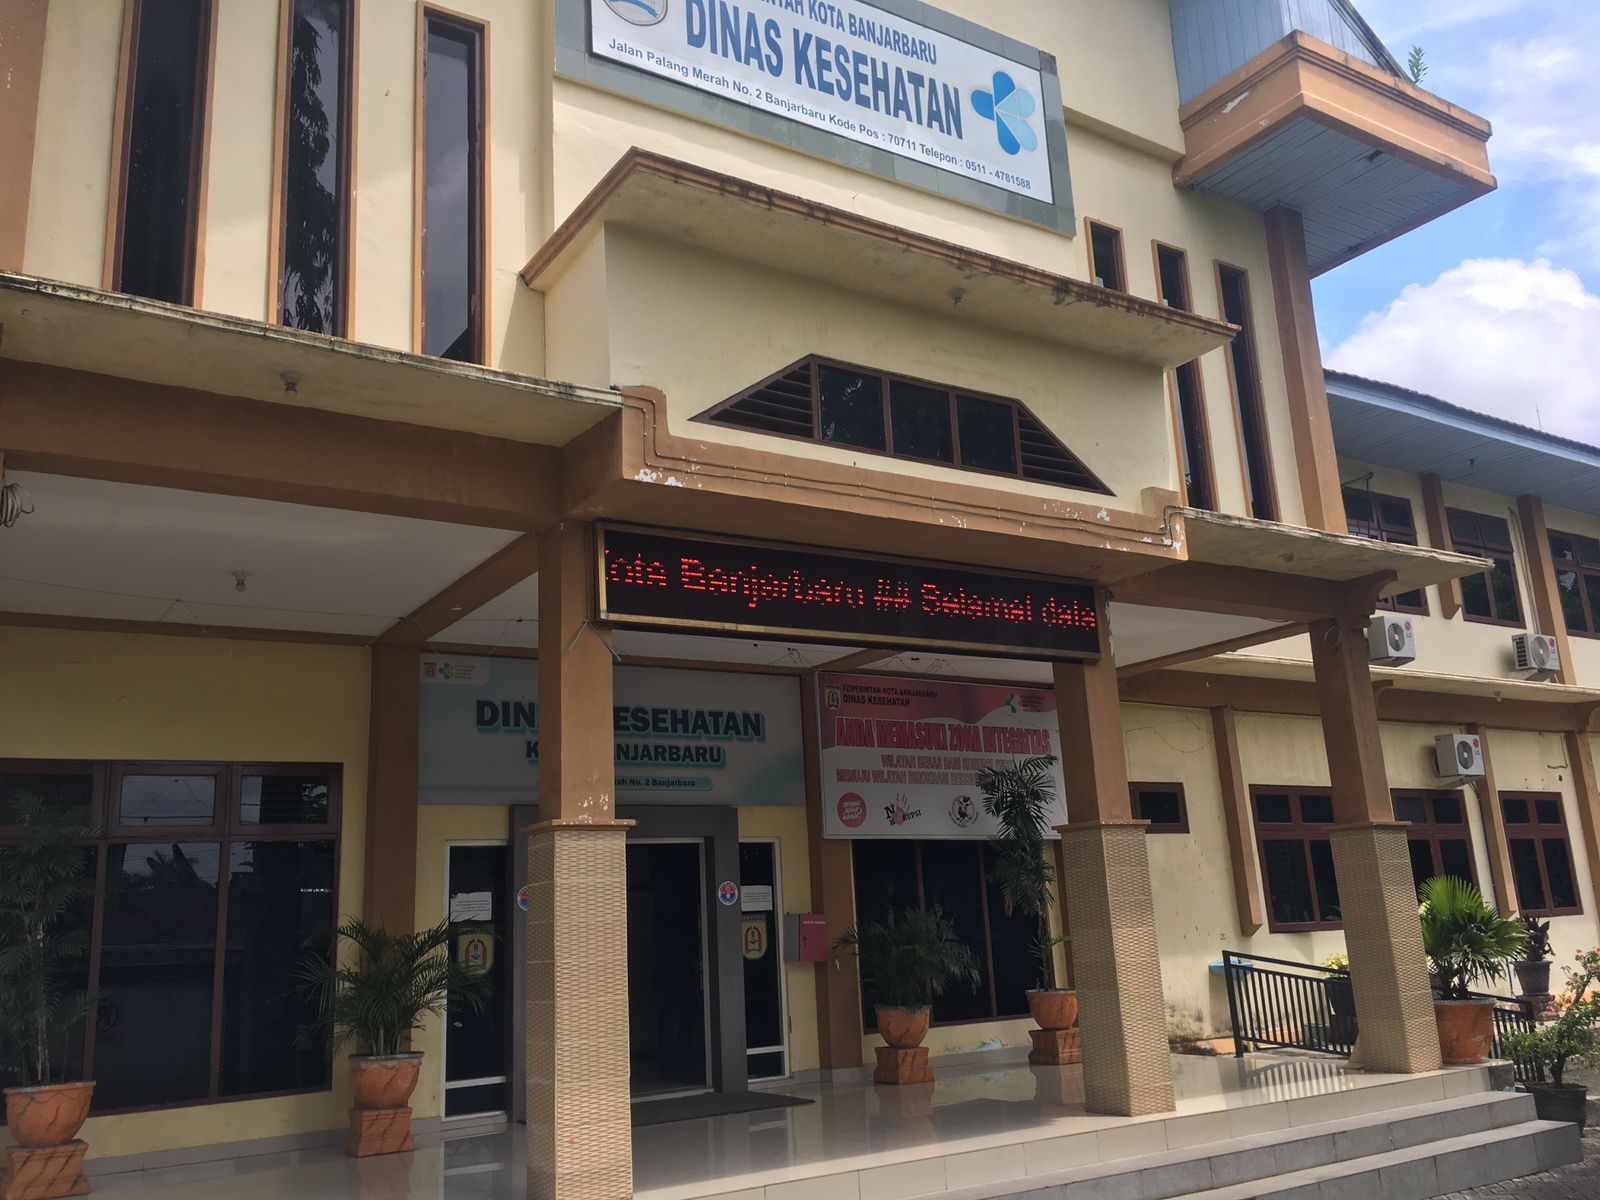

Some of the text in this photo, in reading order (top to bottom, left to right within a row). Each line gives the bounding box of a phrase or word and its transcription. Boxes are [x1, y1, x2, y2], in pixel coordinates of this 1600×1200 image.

[808, 0, 937, 66] KOTA BANJARBARU
[686, 0, 963, 140] DINAS KESEHATAN
[609, 38, 643, 60] Jalan
[647, 51, 689, 77] Palang
[692, 67, 730, 89] Merah
[732, 80, 753, 98] No.
[755, 88, 763, 100] 2
[765, 92, 827, 122] Banjarbaru
[829, 113, 857, 133] Kode
[859, 123, 880, 139] Pos
[888, 133, 917, 152] 70711
[919, 143, 957, 167] Telepon
[965, 159, 987, 176] 0511
[994, 170, 1032, 191] 4781588
[843, 684, 881, 695] PEMERINTAH
[882, 687, 898, 696] KOTA
[843, 694, 911, 707] DINAS KESEHATAN
[613, 706, 762, 737] ESEHATAN
[836, 717, 1052, 756] ANDA MEMASUKI ZONA INTEGRITAS
[614, 743, 722, 764] NJARBARU
[880, 754, 916, 768] WILAYAH
[652, 778, 696, 788] Banjarbaru
[871, 769, 907, 784] WILAYAH
